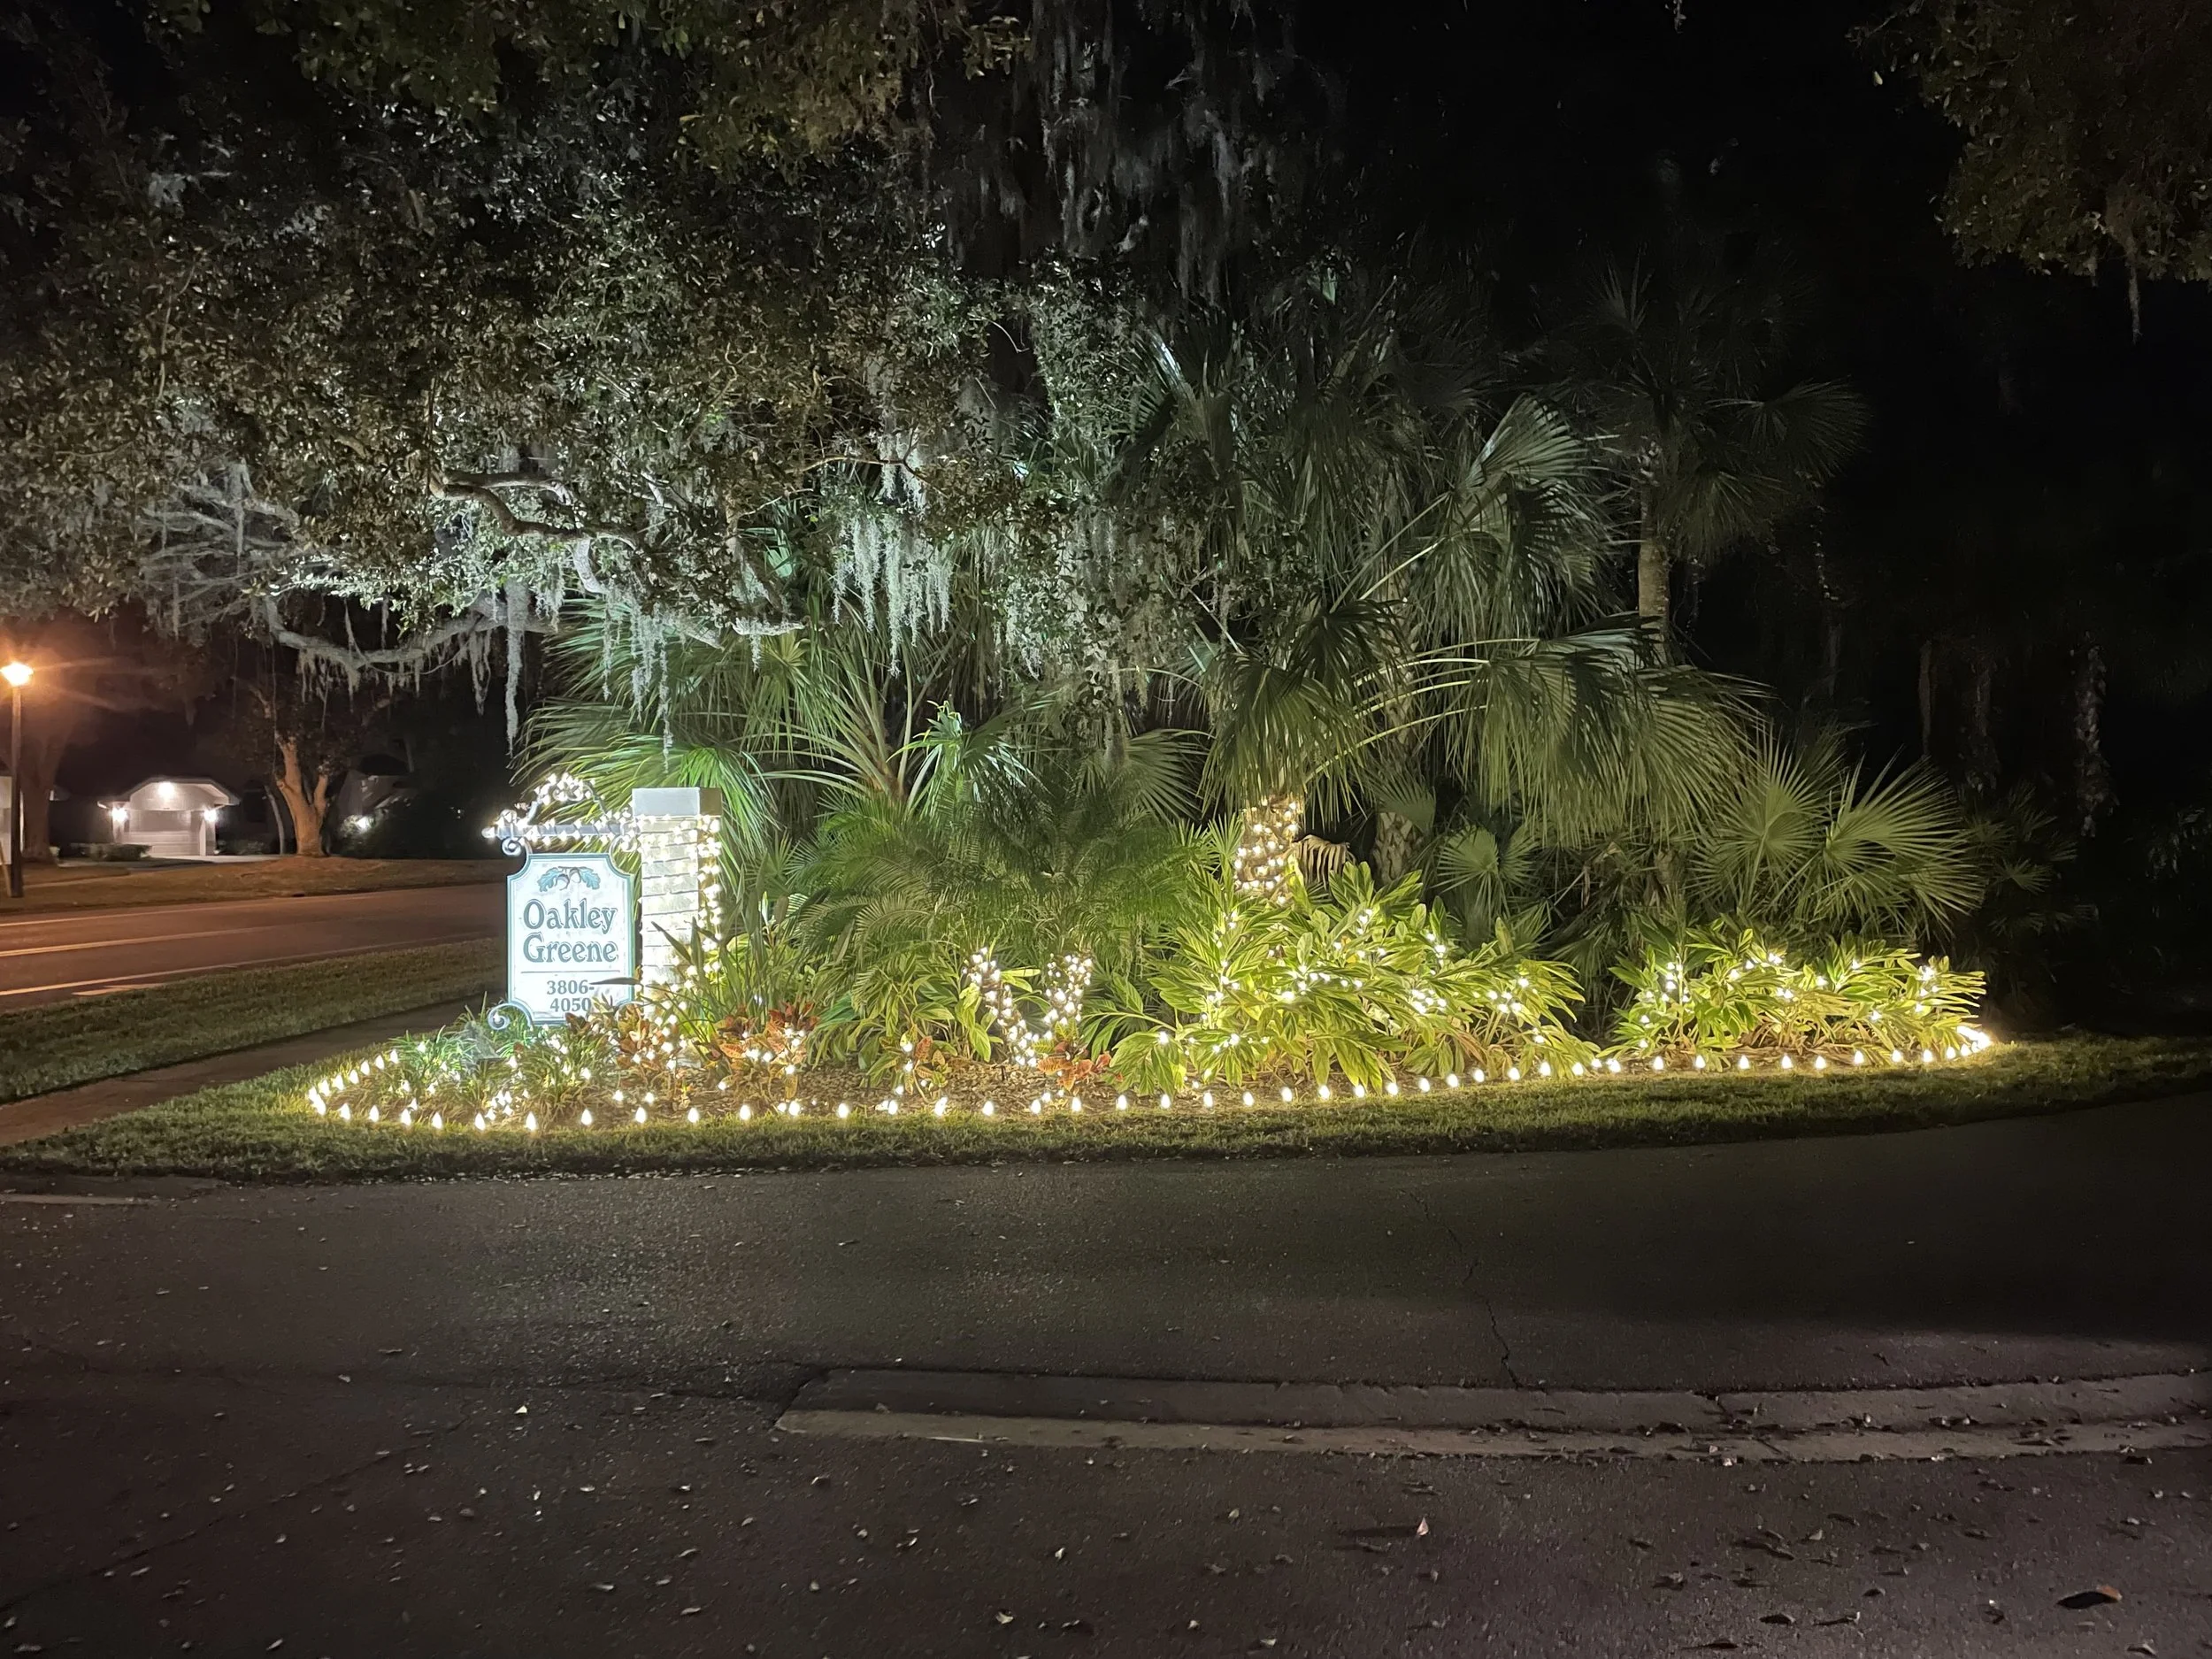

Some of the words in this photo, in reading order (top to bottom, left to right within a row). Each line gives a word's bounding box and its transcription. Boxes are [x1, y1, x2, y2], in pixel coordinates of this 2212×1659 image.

[523, 898, 618, 934] Oakley
[523, 932, 618, 963] Greene
[547, 979, 595, 995] 3806-
[549, 997, 591, 1012] 4050
